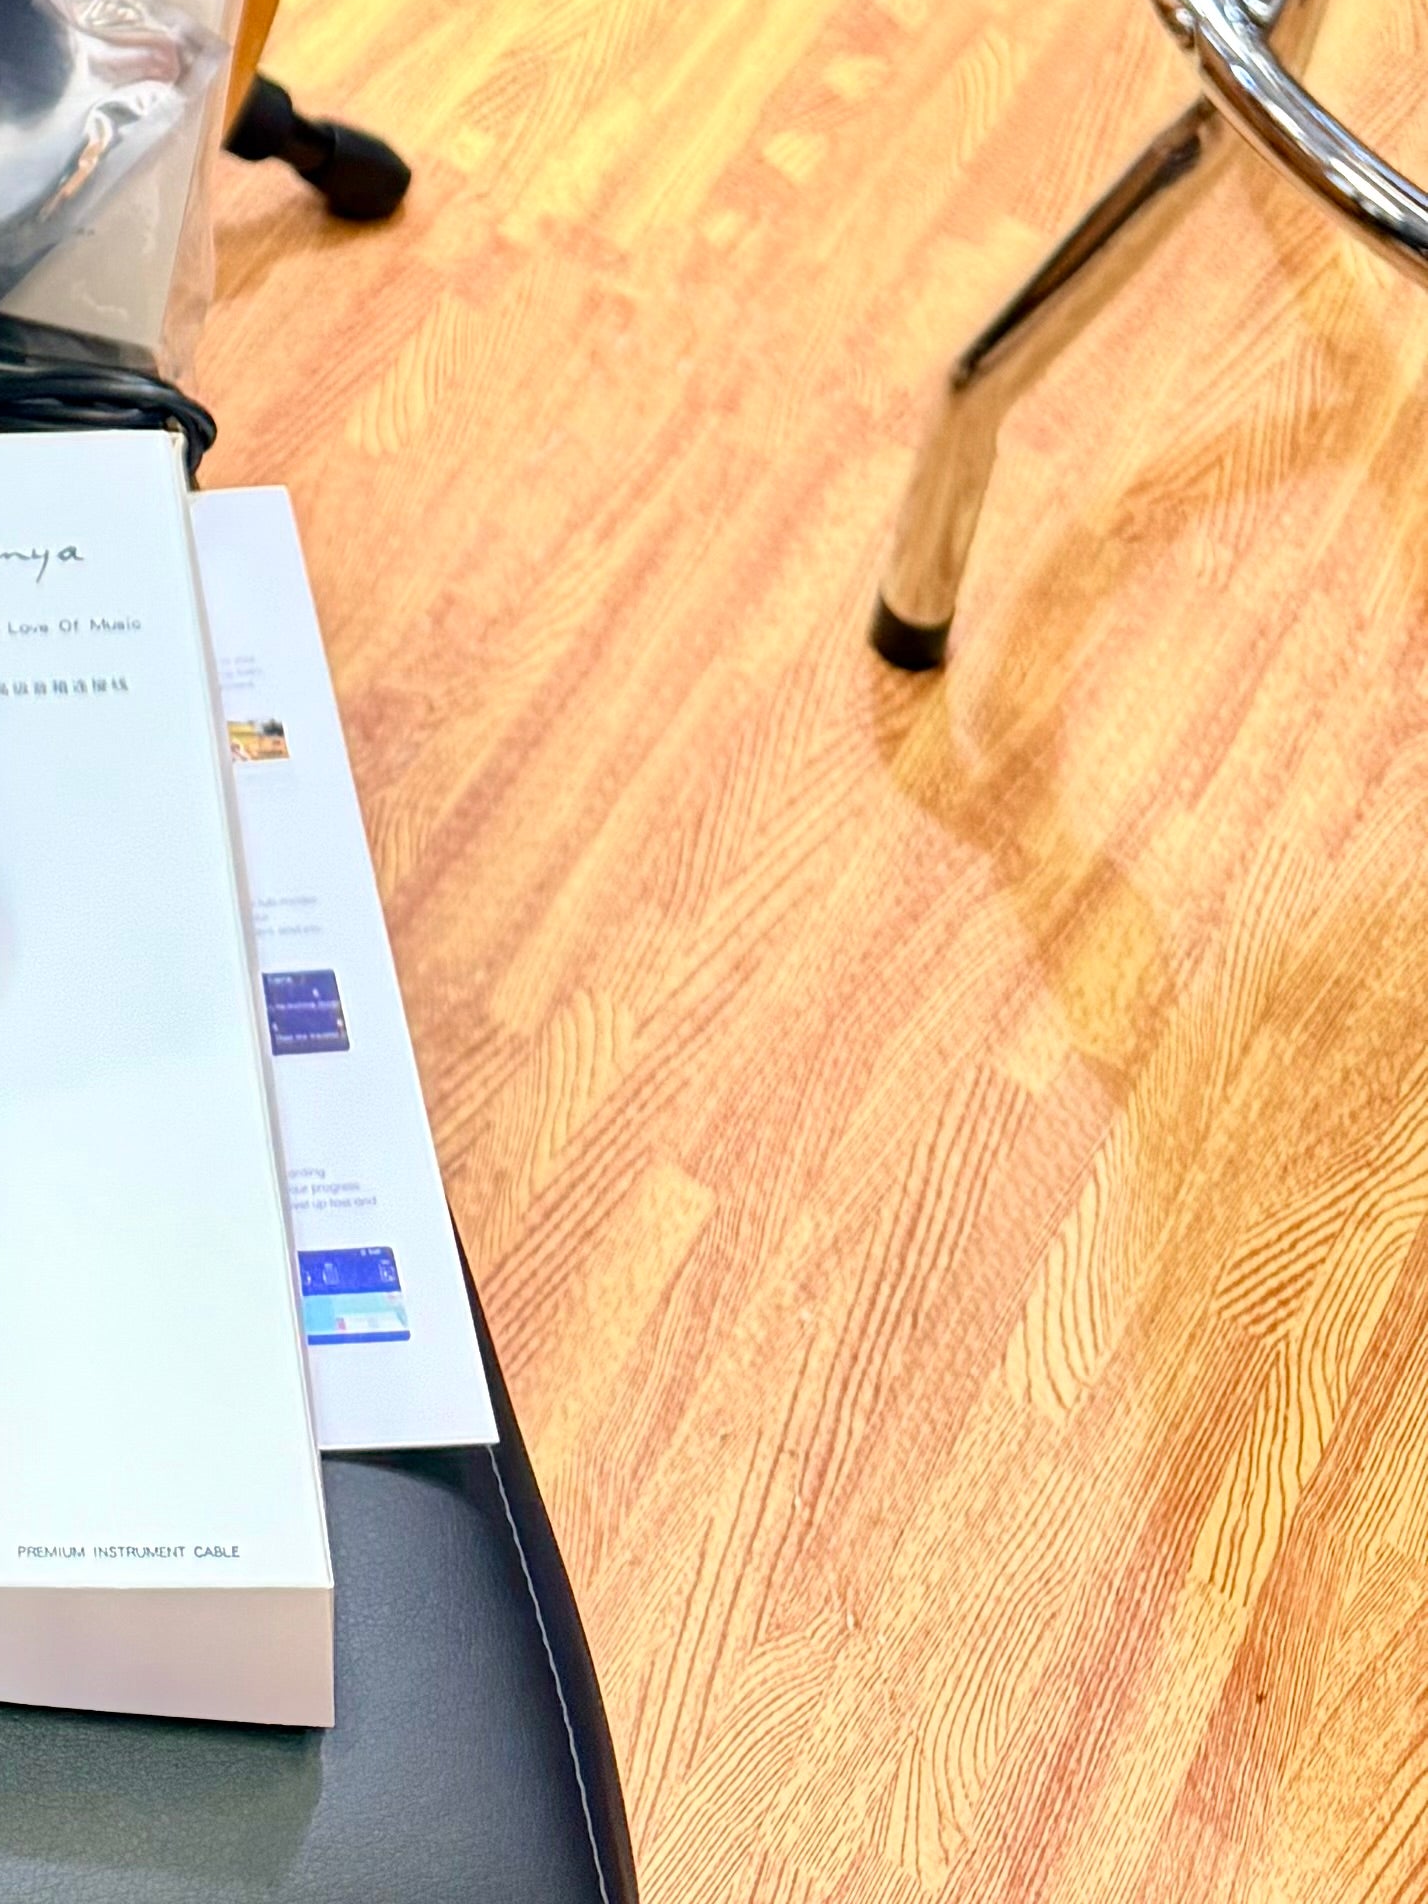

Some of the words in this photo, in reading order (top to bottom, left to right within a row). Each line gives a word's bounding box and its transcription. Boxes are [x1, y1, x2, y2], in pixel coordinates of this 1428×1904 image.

[7, 621, 49, 635] Love
[58, 618, 79, 633] Of
[90, 615, 142, 632] Music
[17, 1545, 86, 1559] PREMIUM
[93, 1545, 187, 1558] INSTRUMENT
[193, 1545, 241, 1559] CABLE
